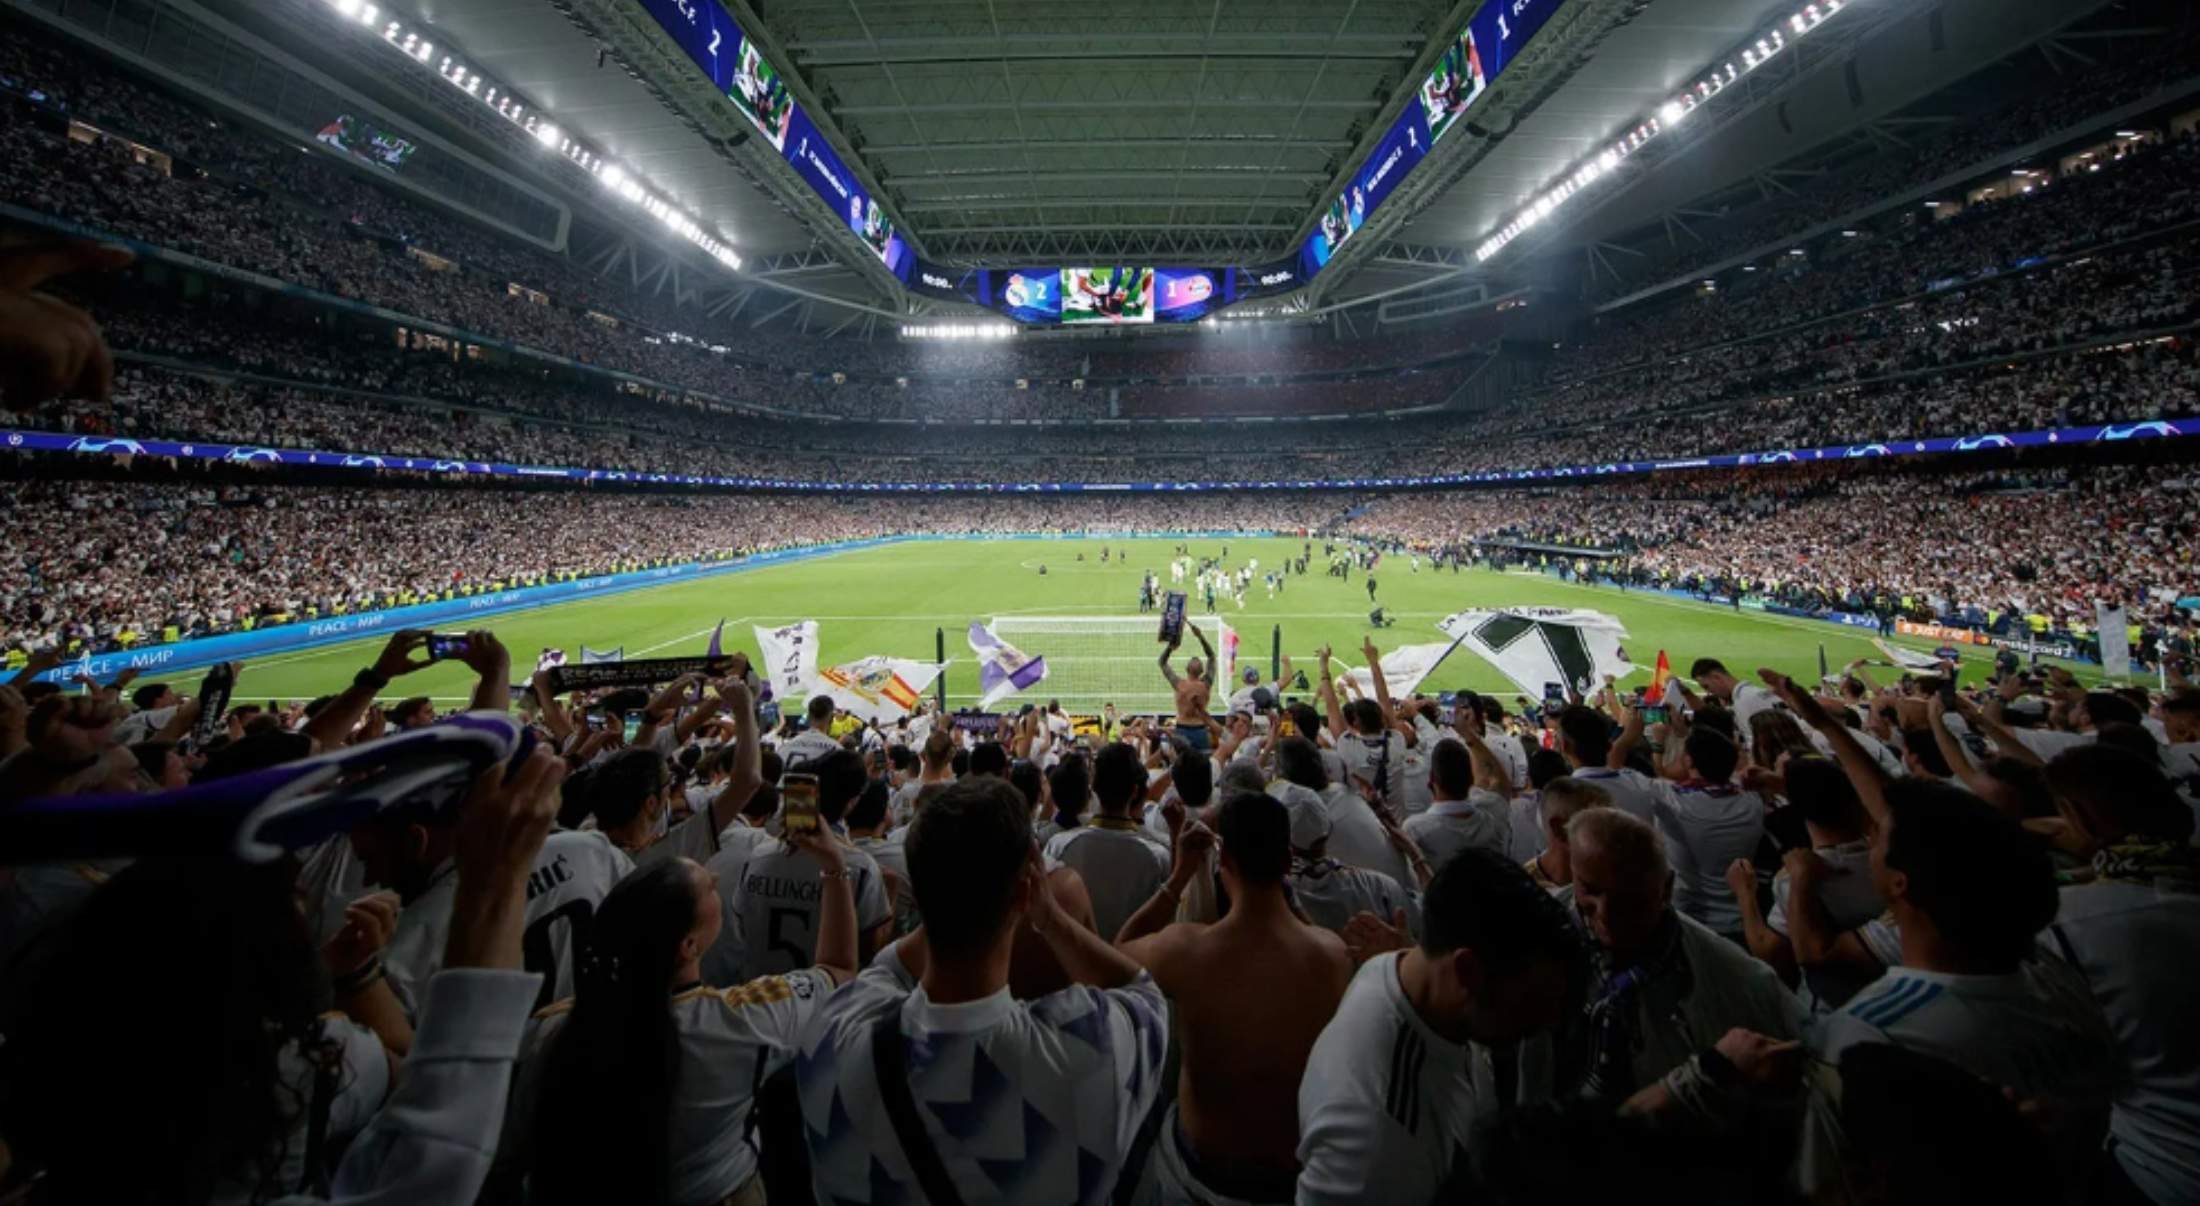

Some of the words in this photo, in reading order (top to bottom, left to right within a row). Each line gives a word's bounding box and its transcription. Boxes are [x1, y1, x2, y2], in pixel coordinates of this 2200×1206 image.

[1497, 13, 1511, 40] 1
[708, 28, 721, 57] 2
[1036, 282, 1048, 300] 2
[1167, 281, 1177, 298] 1
[1991, 638, 2062, 656] mastecard
[49, 659, 112, 682] PEACE
[749, 874, 822, 901] BELLINGH
[768, 907, 810, 969] 5
